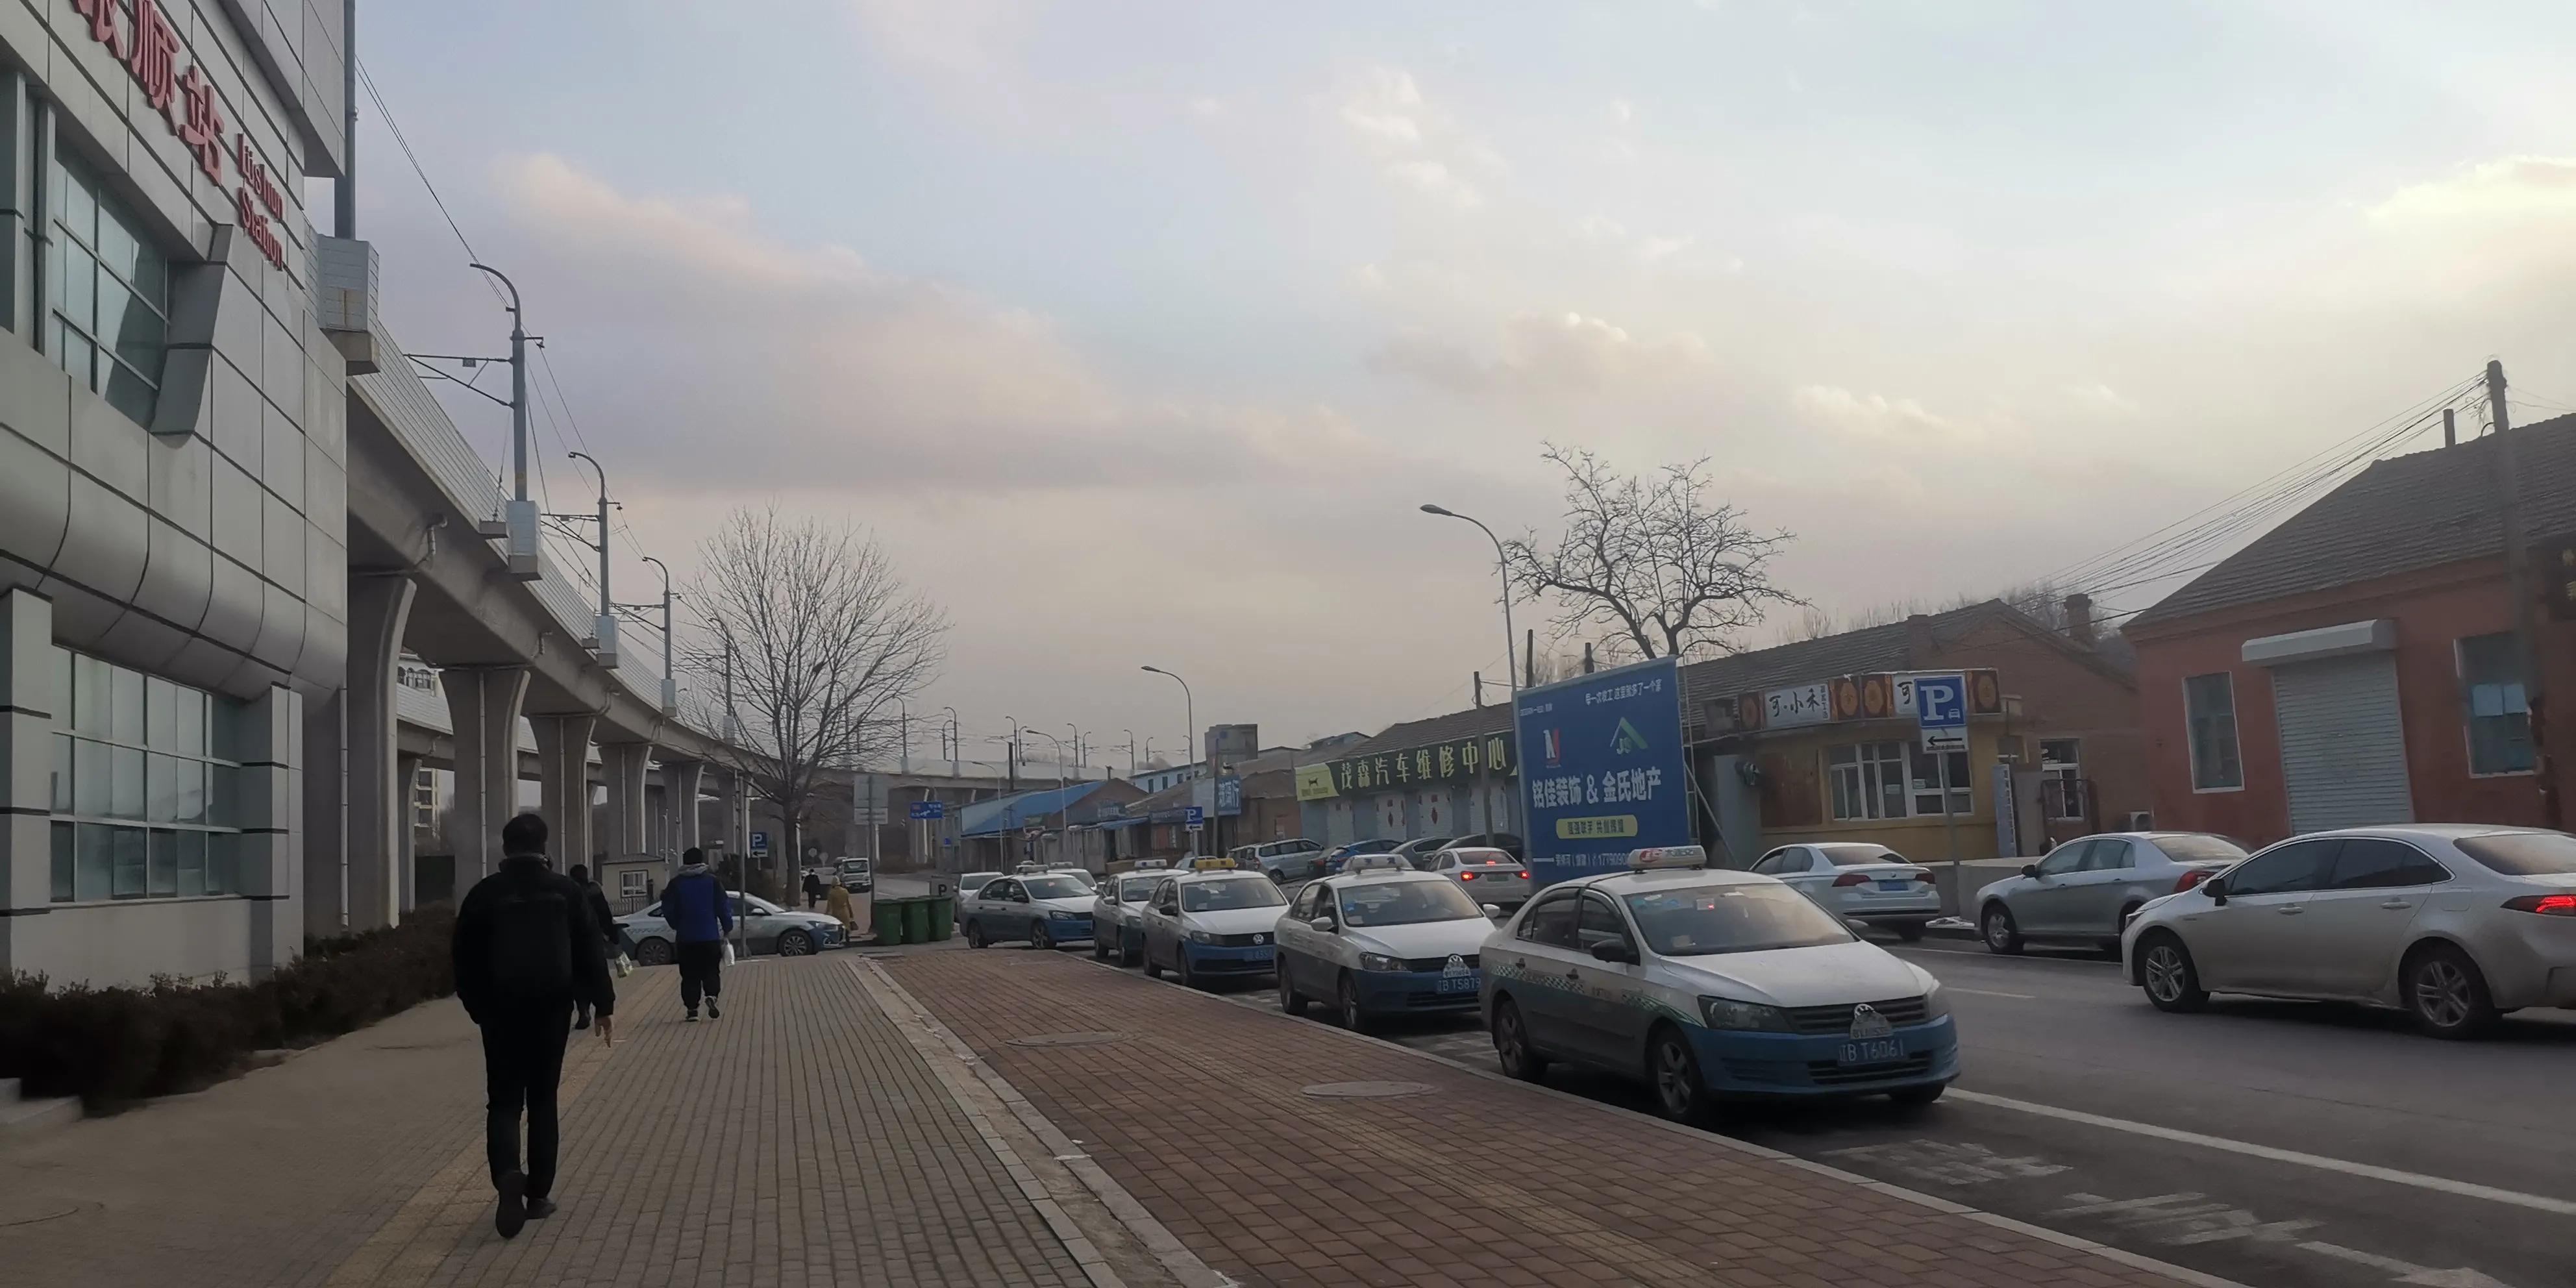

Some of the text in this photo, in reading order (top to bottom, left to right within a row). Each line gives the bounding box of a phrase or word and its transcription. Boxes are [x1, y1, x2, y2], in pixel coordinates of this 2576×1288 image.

[237, 186, 283, 271] Station
[1920, 685, 1954, 721] P
[1586, 774, 1599, 804] &
[1602, 766, 1662, 803] 金氏地产
[752, 833, 763, 846] P
